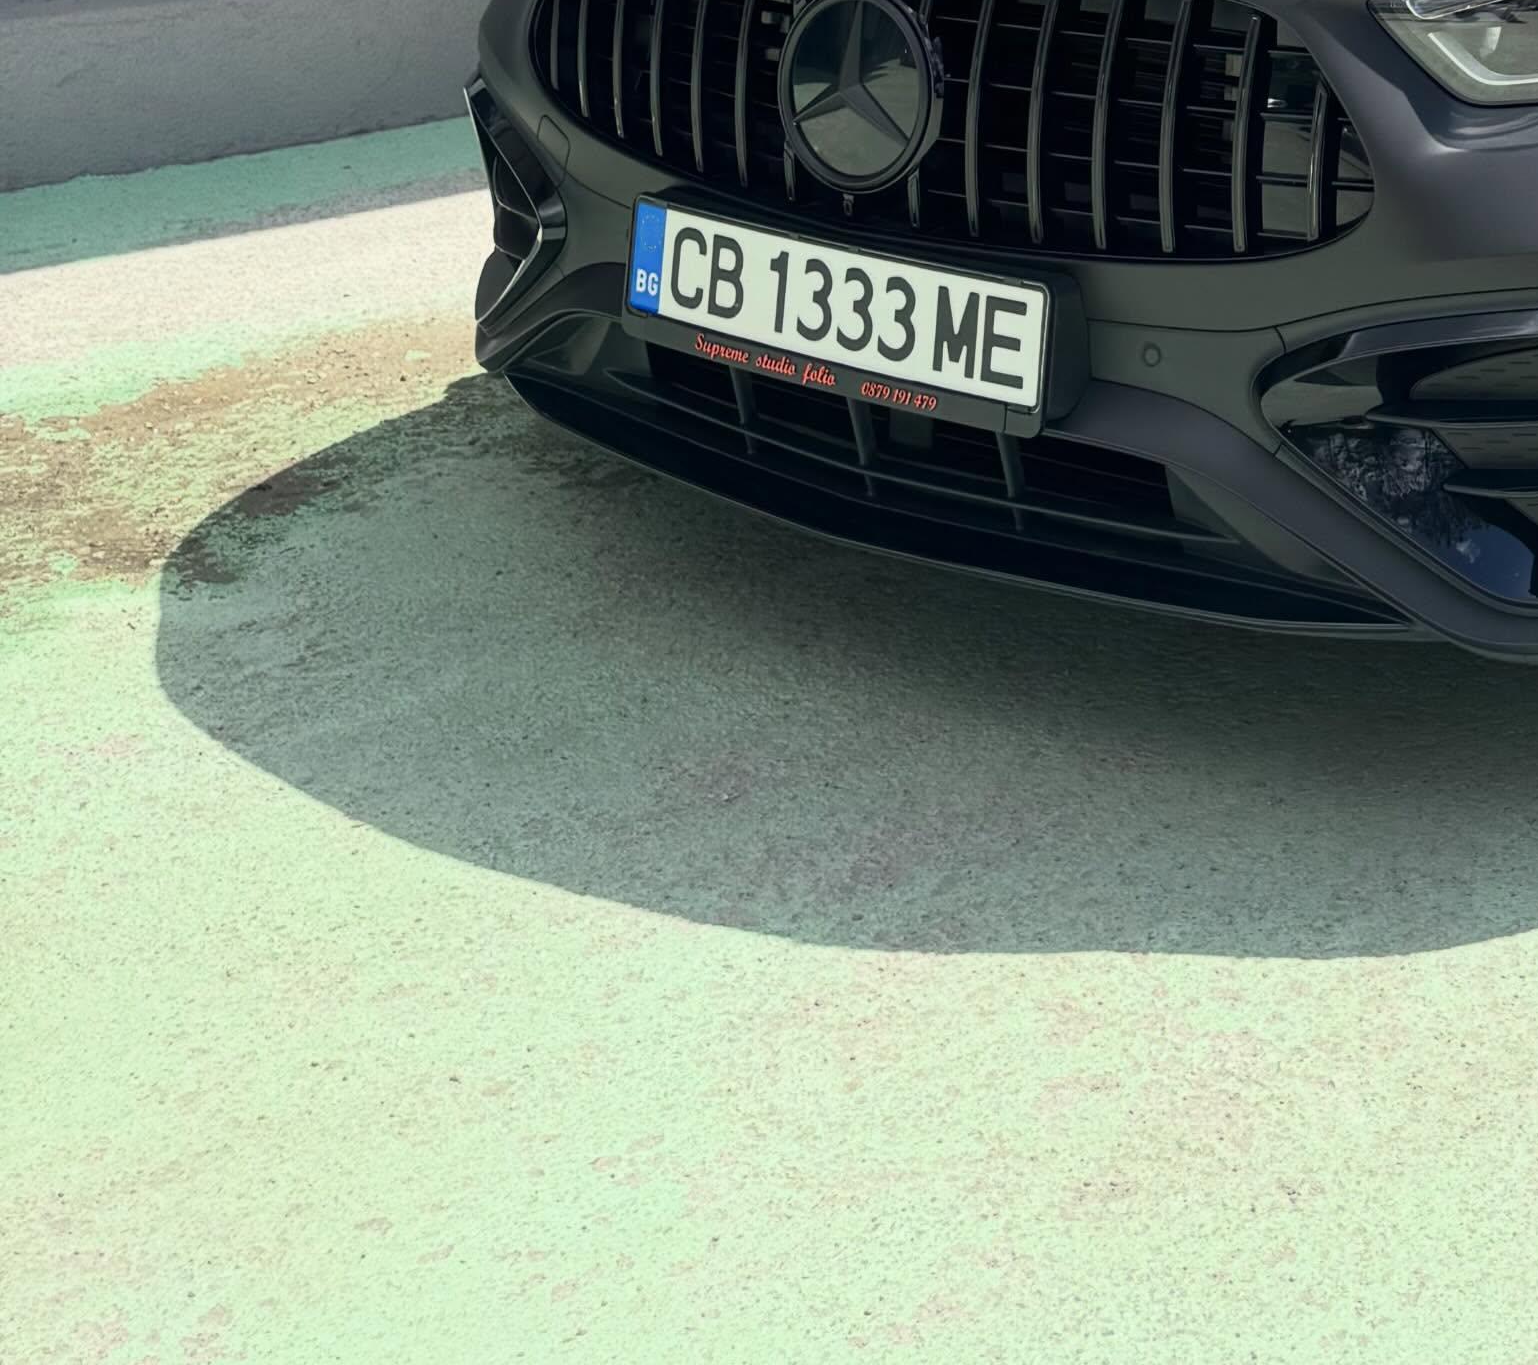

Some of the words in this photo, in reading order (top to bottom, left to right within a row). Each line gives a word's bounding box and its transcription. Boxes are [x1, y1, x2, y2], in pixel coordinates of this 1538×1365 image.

[635, 268, 659, 296] BG
[670, 227, 745, 319] CB
[770, 250, 916, 362] 1333
[932, 285, 1028, 390] ME
[695, 332, 749, 365] Supreme
[755, 352, 796, 376] studio
[802, 363, 836, 387] folio
[860, 381, 890, 400] 0879
[892, 385, 911, 406] 191
[913, 391, 937, 412] 479
